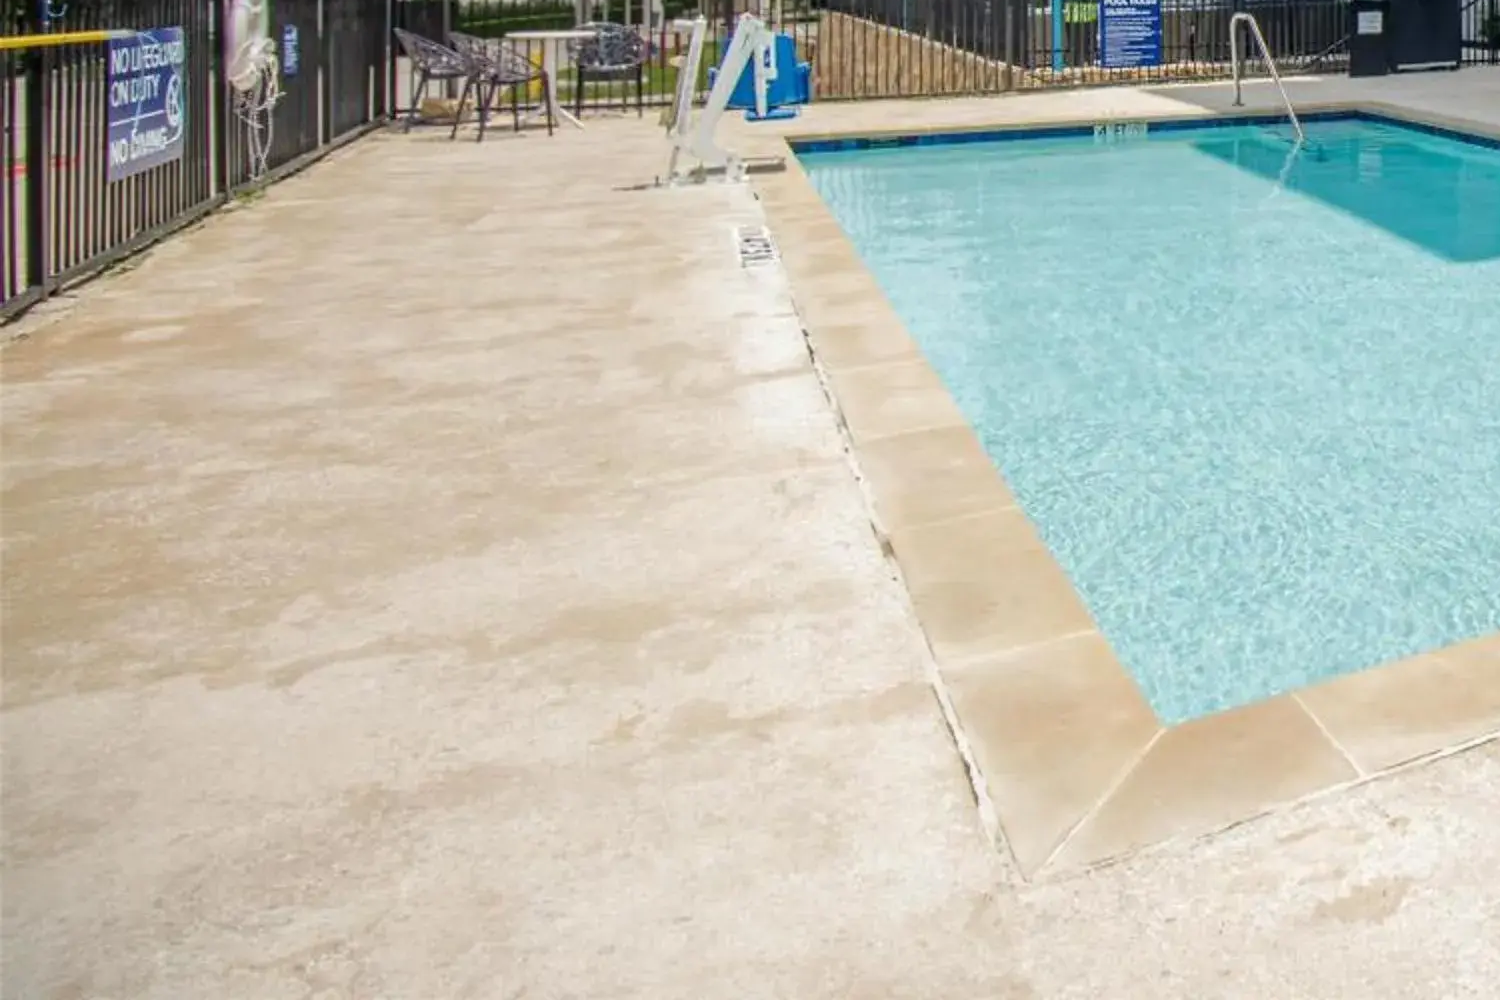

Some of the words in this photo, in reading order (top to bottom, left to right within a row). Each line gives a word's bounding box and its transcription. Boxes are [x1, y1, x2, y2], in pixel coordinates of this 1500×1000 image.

[112, 49, 130, 76] NO
[112, 81, 129, 107] ON
[131, 75, 161, 103] DUTY
[112, 139, 128, 165] NO
[129, 128, 168, 157] DIVING
